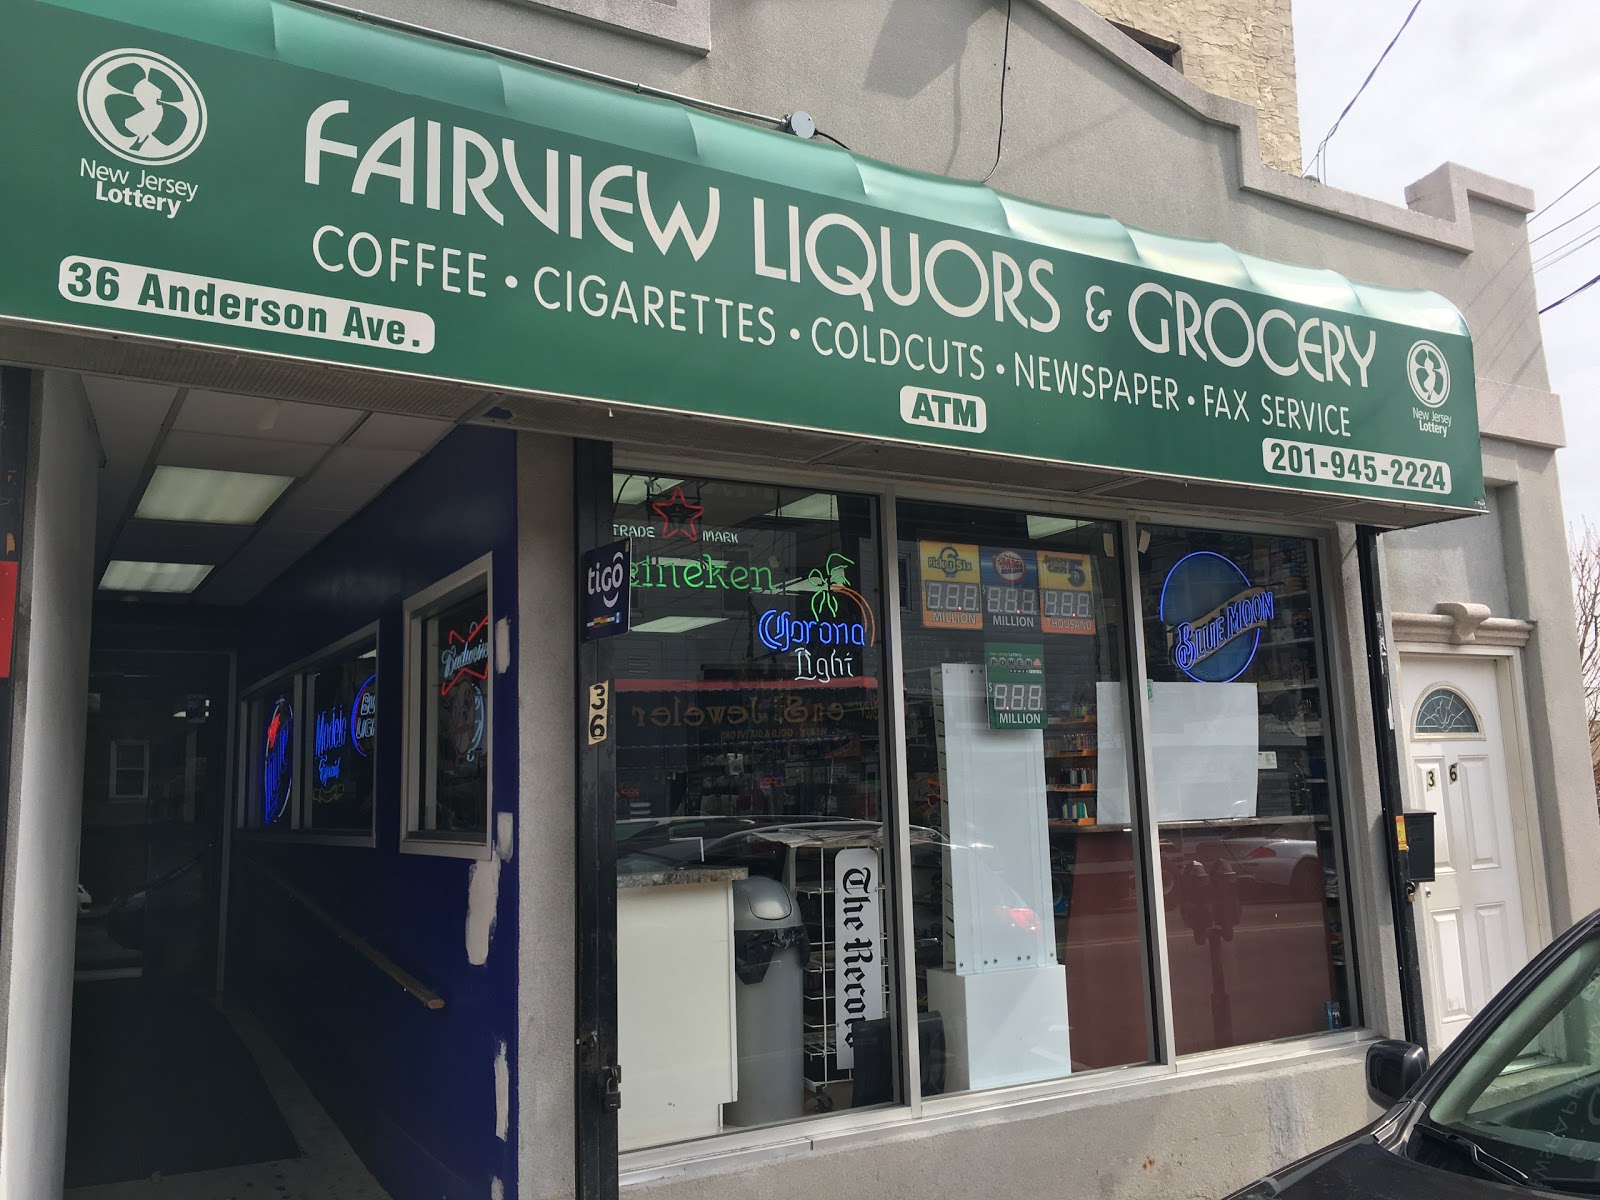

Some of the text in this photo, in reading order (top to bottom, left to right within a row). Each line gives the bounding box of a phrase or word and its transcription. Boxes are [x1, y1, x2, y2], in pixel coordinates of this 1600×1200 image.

[80, 157, 199, 203] New Jersey
[95, 180, 182, 219] Lottery
[304, 99, 1377, 388] FAIRVIEW LIQUORS & GROCERY
[67, 261, 421, 348] 36 Anderson Ave.
[312, 224, 1351, 438] COFFEE CIGARETTES COLDCUTS NEWSPAPER FAX SERVICE
[911, 392, 977, 428] ATM
[1412, 406, 1452, 427] New Jersey
[1419, 419, 1448, 438] Lottery
[1270, 442, 1446, 491] 201-945-2224
[613, 524, 739, 543] TRADE MARK
[630, 554, 777, 590] eineken
[758, 610, 865, 650] Corona
[932, 611, 976, 625] MILLION
[992, 614, 1034, 627] MILLION
[1046, 618, 1092, 630] THOUSAND
[999, 712, 1041, 724] MILLION
[841, 867, 872, 932] The
